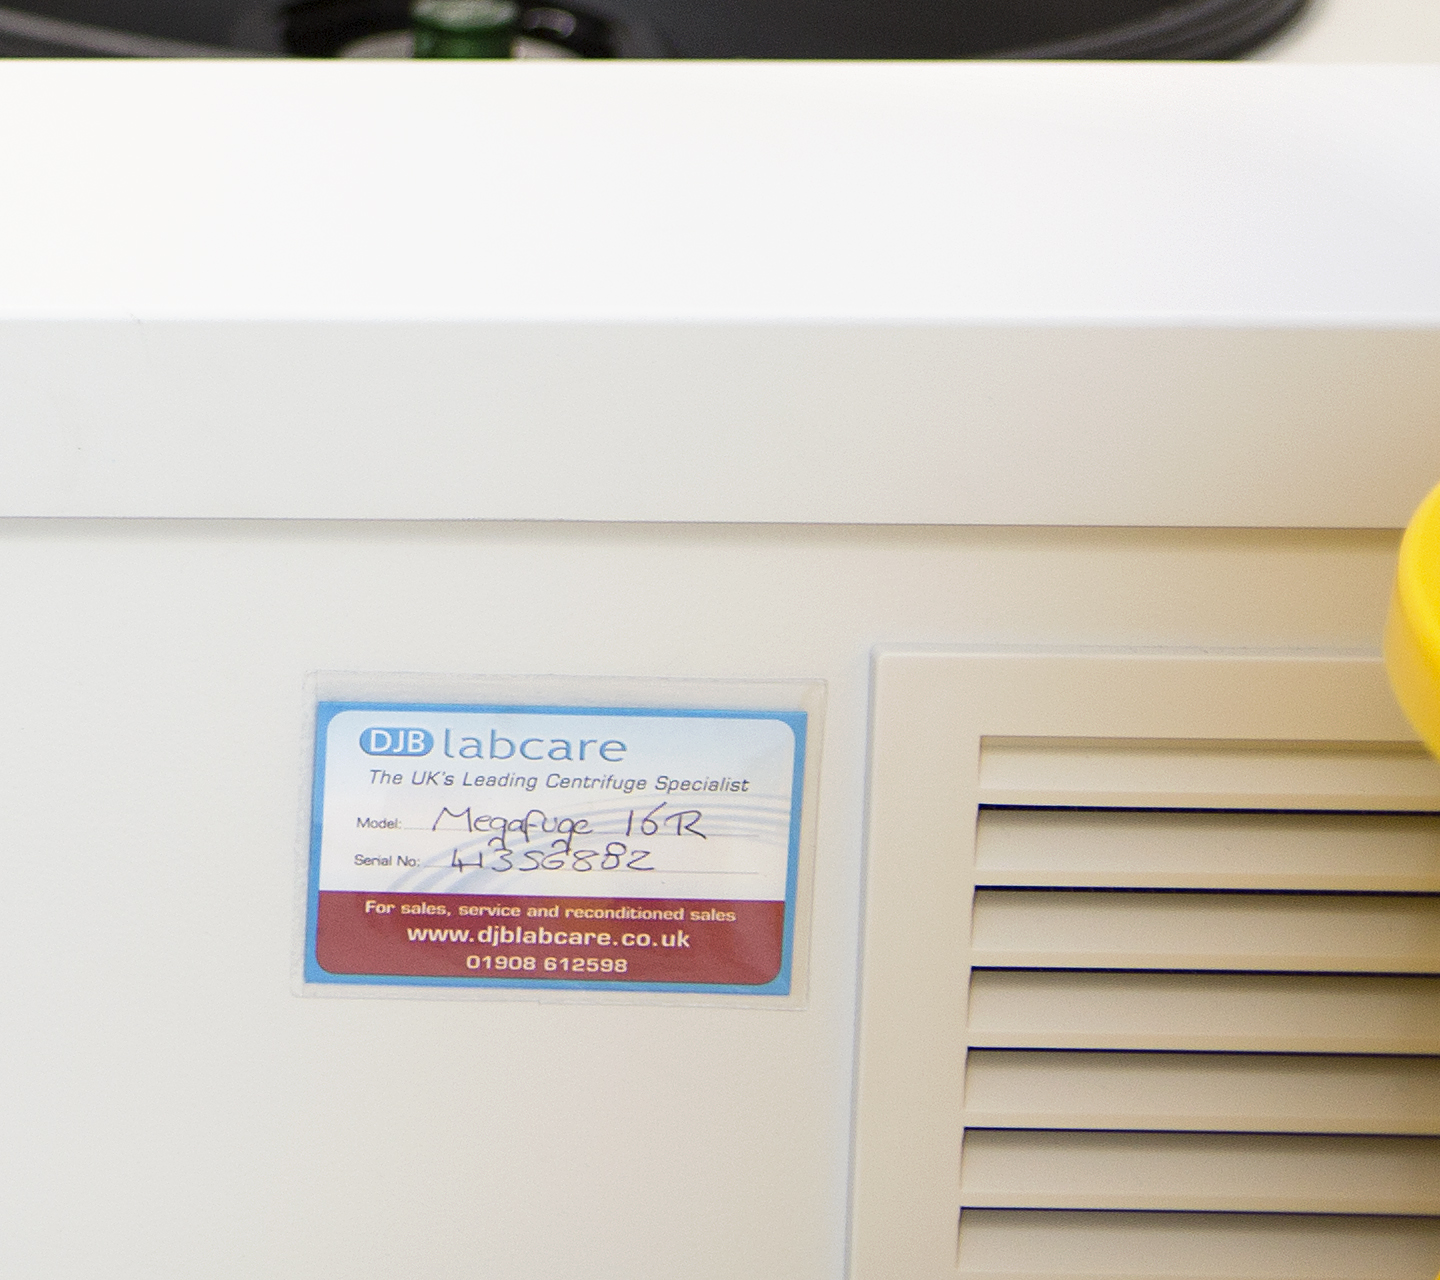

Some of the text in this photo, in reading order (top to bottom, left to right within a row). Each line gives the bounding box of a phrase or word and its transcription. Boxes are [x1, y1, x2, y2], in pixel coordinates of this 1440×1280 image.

[369, 728, 627, 762] DJB labcare
[370, 769, 750, 794] The UK's Leading Centrifuge Specialist
[356, 801, 708, 855] Model: Megafuge 16R
[354, 853, 392, 867] Serial
[397, 855, 420, 868] No:
[365, 900, 737, 922] For sales, service and reconditioned sales
[407, 926, 691, 949] www.djblabcare.co.uk
[466, 954, 628, 973] 01908 612598
